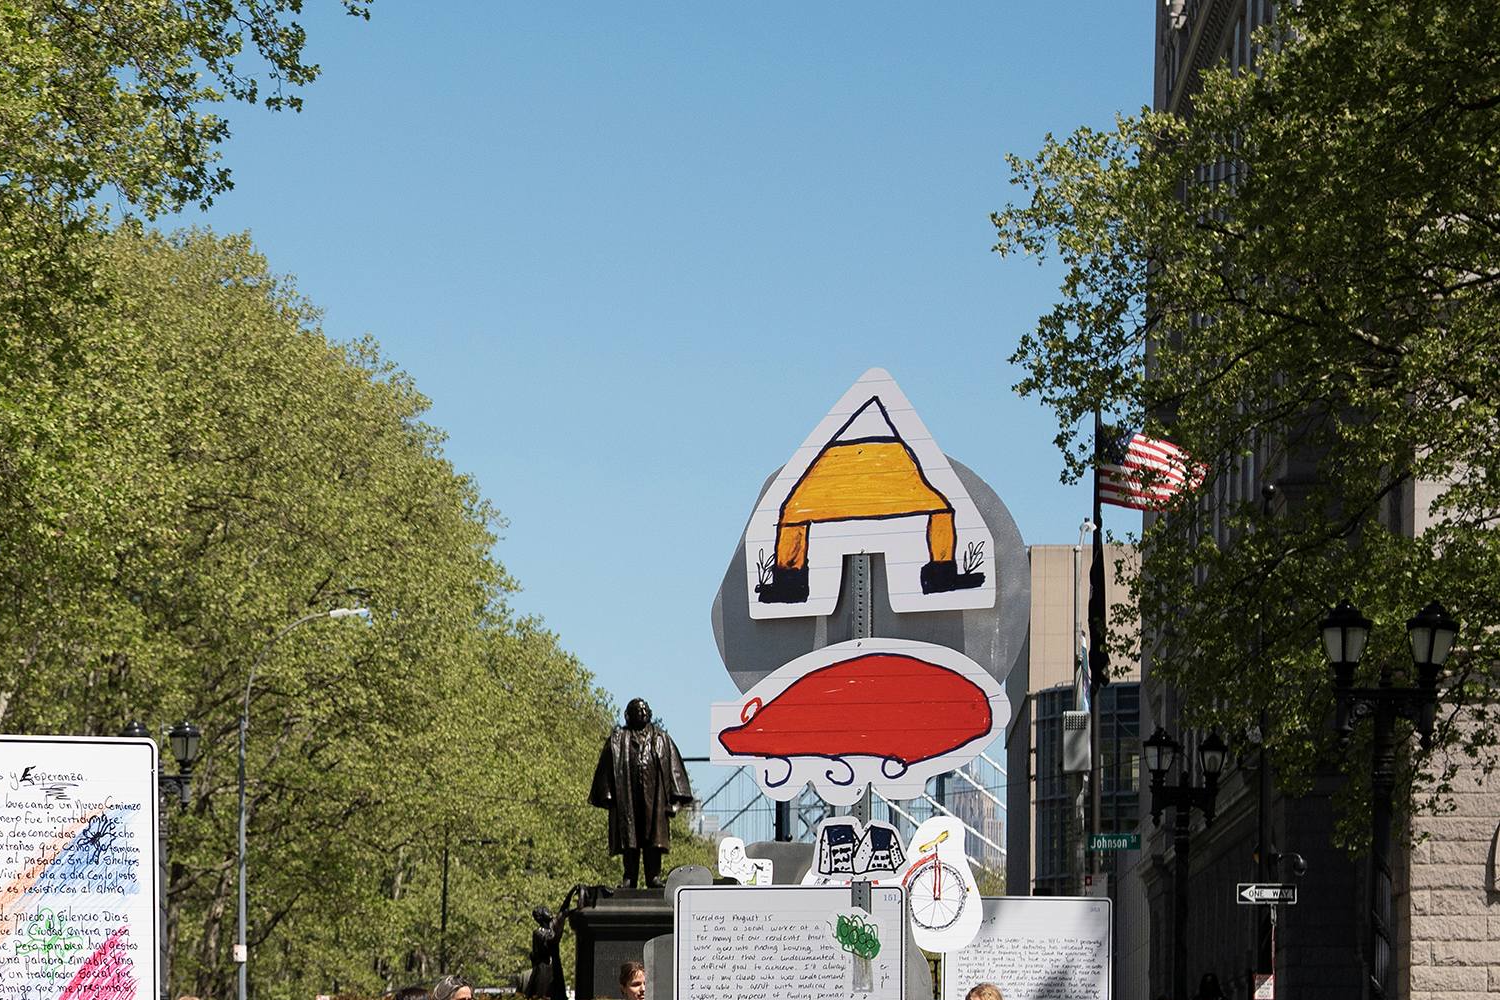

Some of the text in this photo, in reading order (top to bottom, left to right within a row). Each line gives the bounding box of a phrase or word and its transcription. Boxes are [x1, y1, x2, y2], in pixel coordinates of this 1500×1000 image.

[5, 793, 54, 809] buscando
[1090, 836, 1128, 849] Johnson
[1248, 889, 1292, 898] ONE WAY
[692, 913, 774, 924] Tuesday August 15
[712, 935, 732, 943] many
